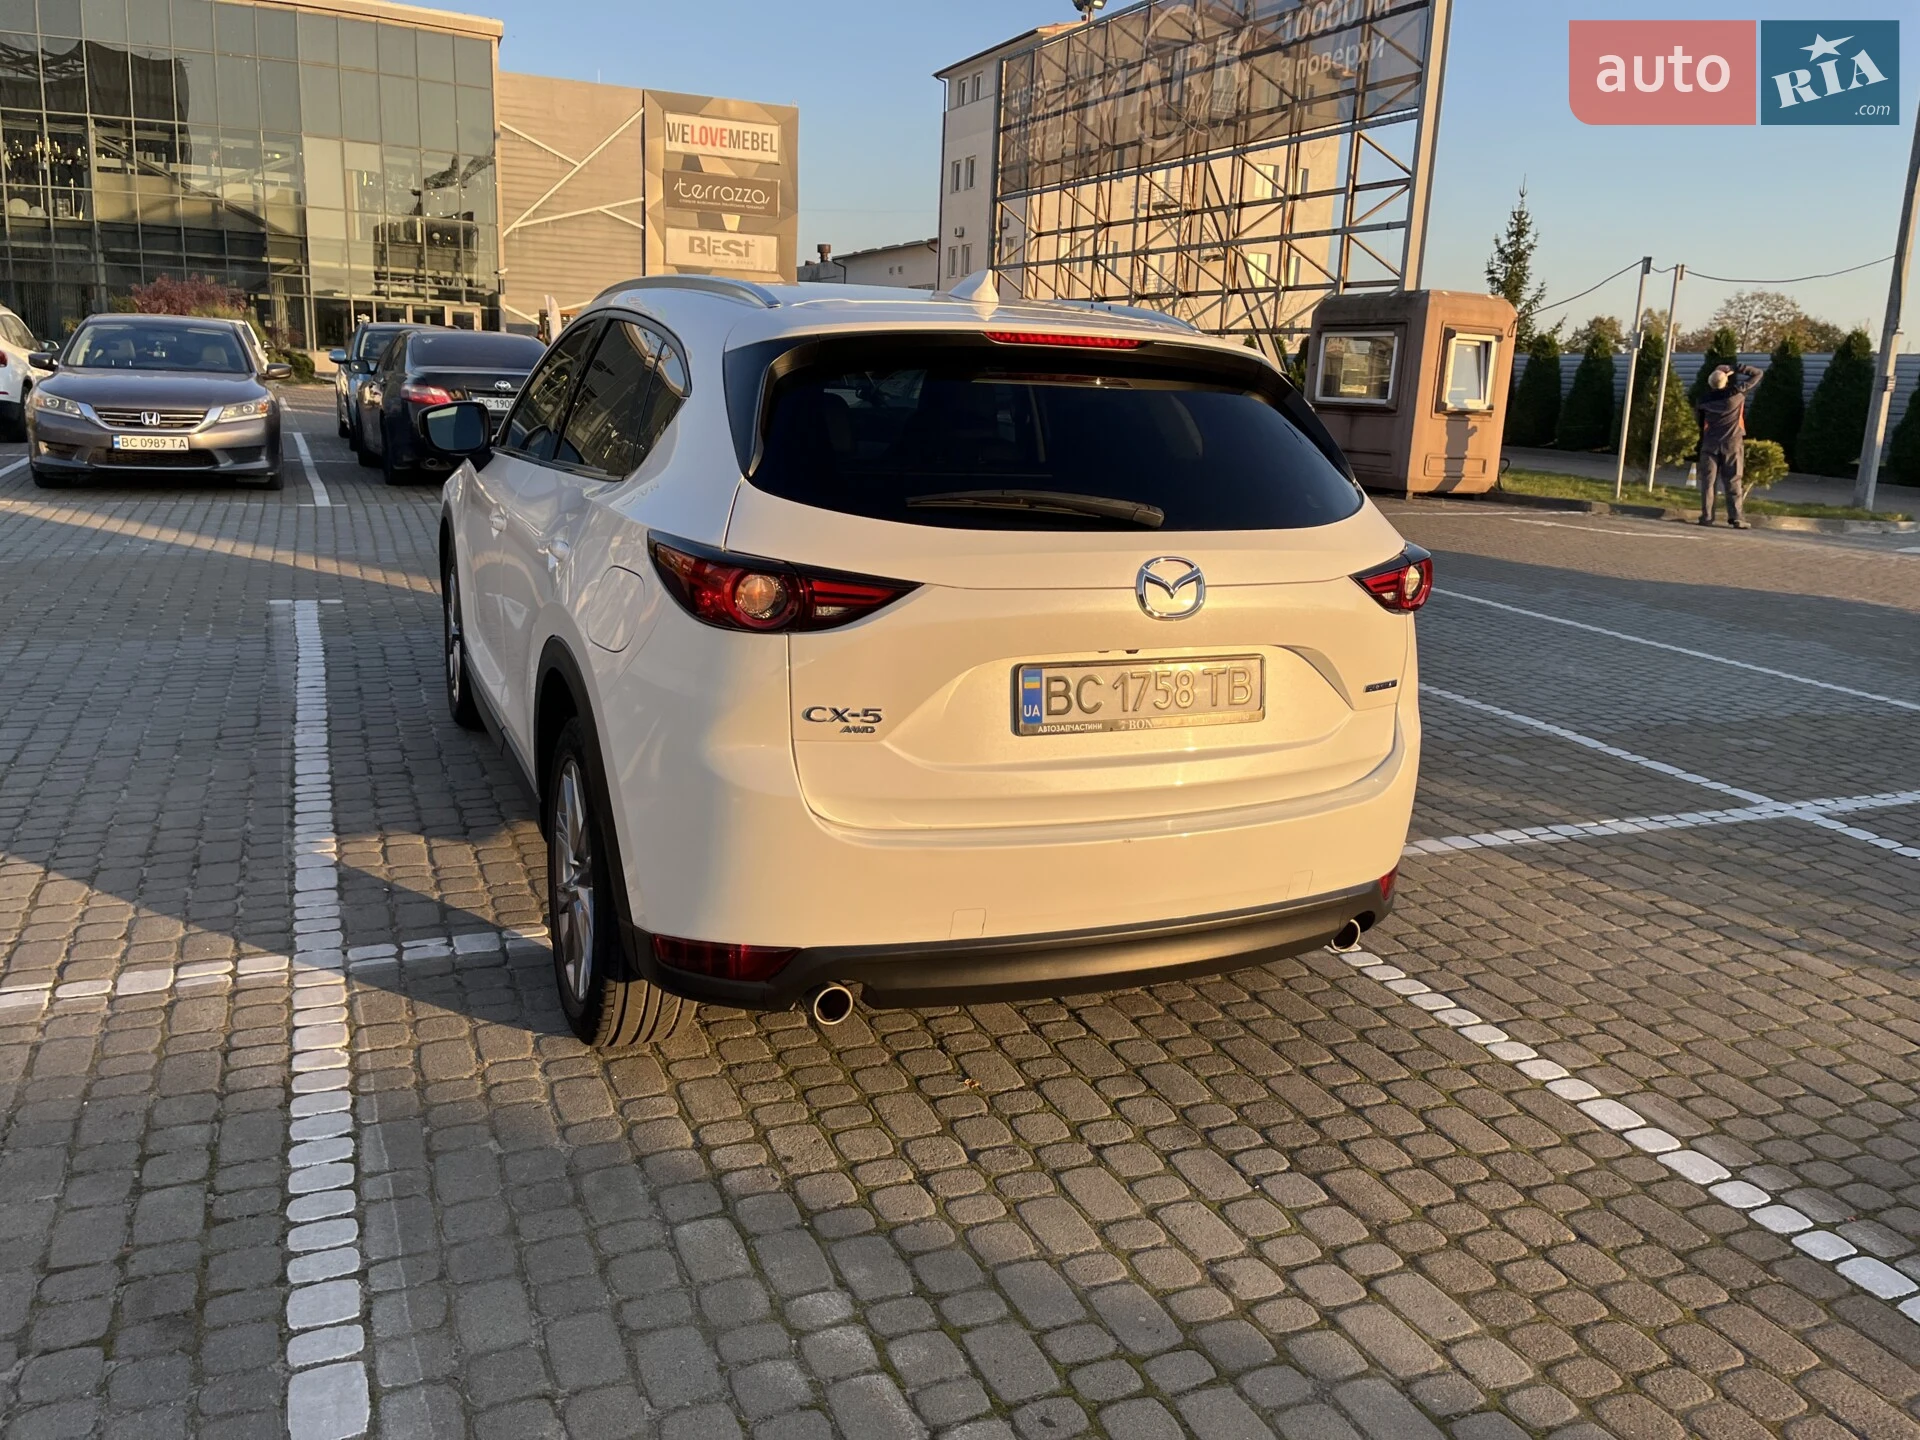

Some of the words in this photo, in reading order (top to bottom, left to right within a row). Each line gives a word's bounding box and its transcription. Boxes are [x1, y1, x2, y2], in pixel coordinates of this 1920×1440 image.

[1296, 37, 1386, 80] поверхи
[666, 121, 778, 154] WELOVEMEBEL
[674, 177, 770, 205] terrazza
[121, 437, 138, 448] BC
[140, 438, 167, 449] 0989
[169, 438, 187, 449] TA
[1046, 674, 1104, 716] BC
[1112, 669, 1196, 713] 1758
[1202, 666, 1254, 707] TB
[801, 705, 882, 724] CX-5
[1023, 704, 1041, 717] UA
[839, 725, 876, 734] AWD
[1037, 722, 1103, 733] АВТОЗАПЧАСТИНИ
